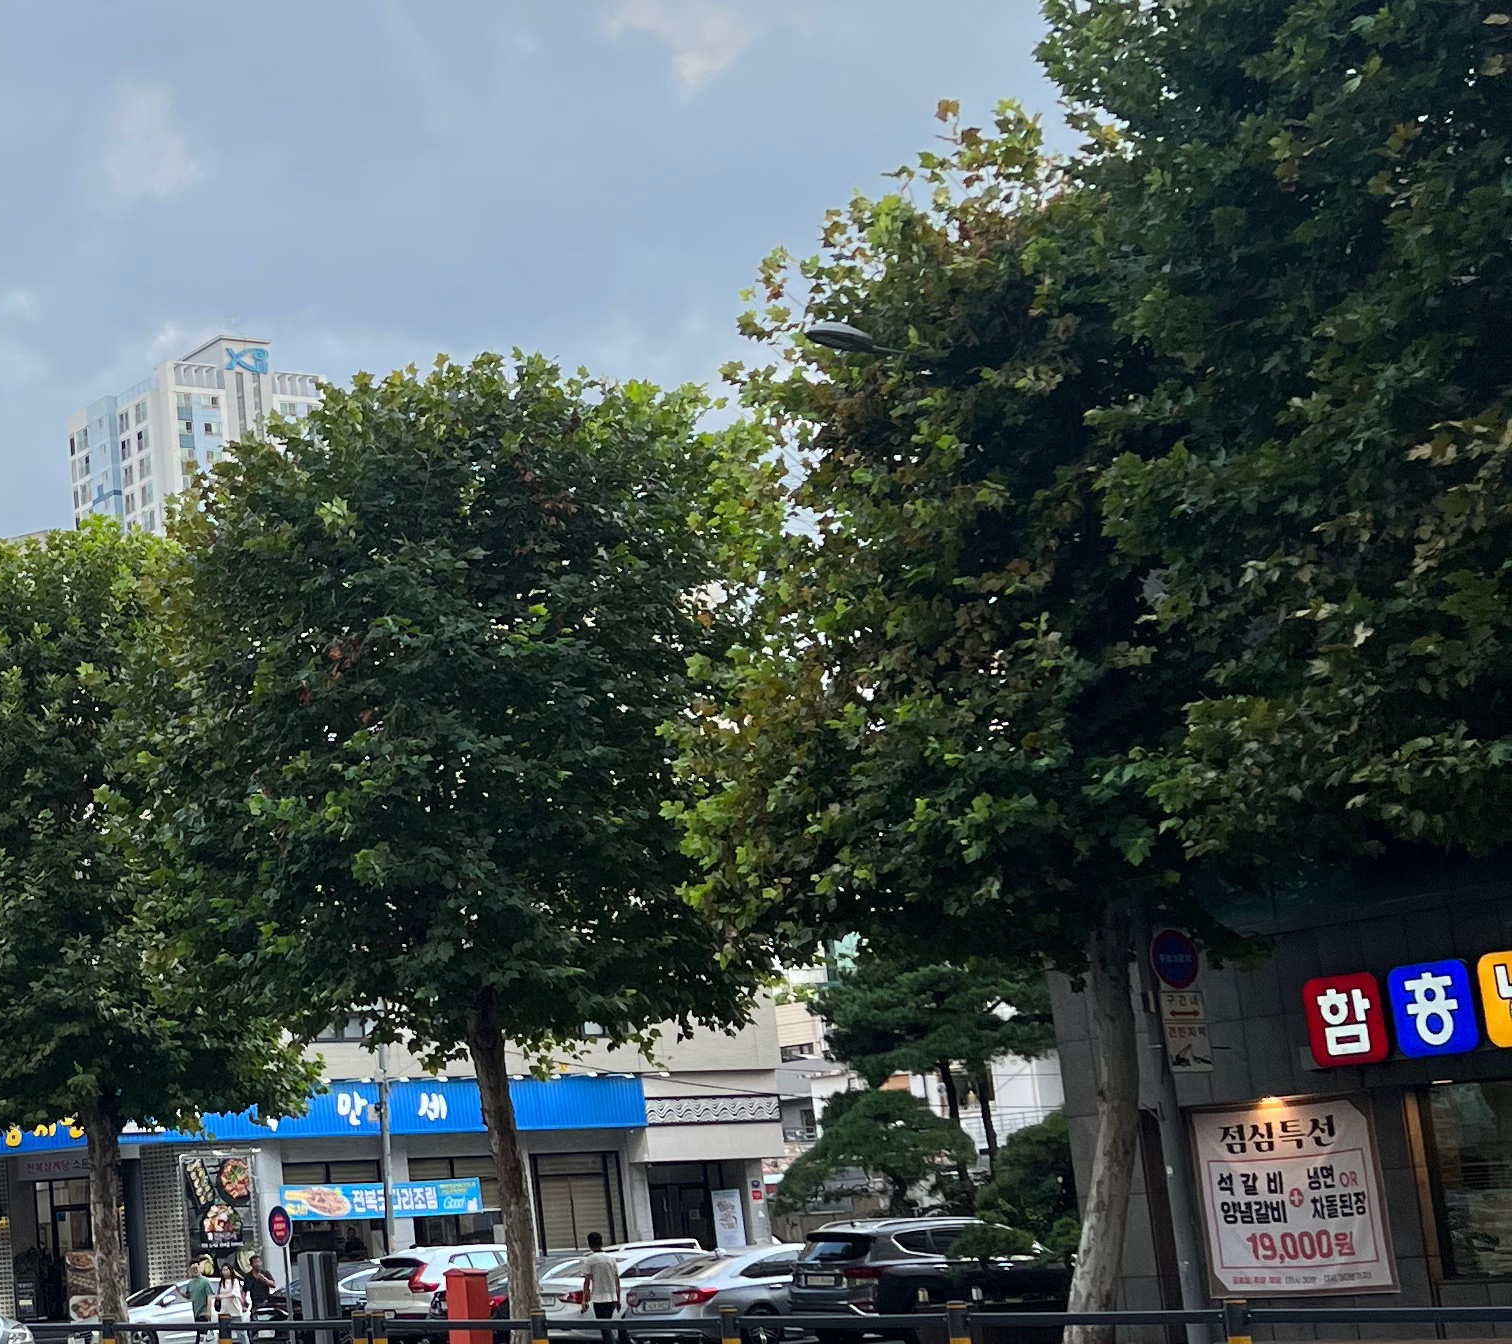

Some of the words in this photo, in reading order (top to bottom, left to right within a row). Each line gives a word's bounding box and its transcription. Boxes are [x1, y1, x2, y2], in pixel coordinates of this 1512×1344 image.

[1218, 1115, 1336, 1154] 점심특선
[1307, 1165, 1336, 1190] 냉면
[1339, 1171, 1358, 1188] OR
[1221, 1200, 1288, 1224] 양념갈비
[1310, 1191, 1366, 1220] 차돌된장
[1247, 1229, 1355, 1263] 19,000원
